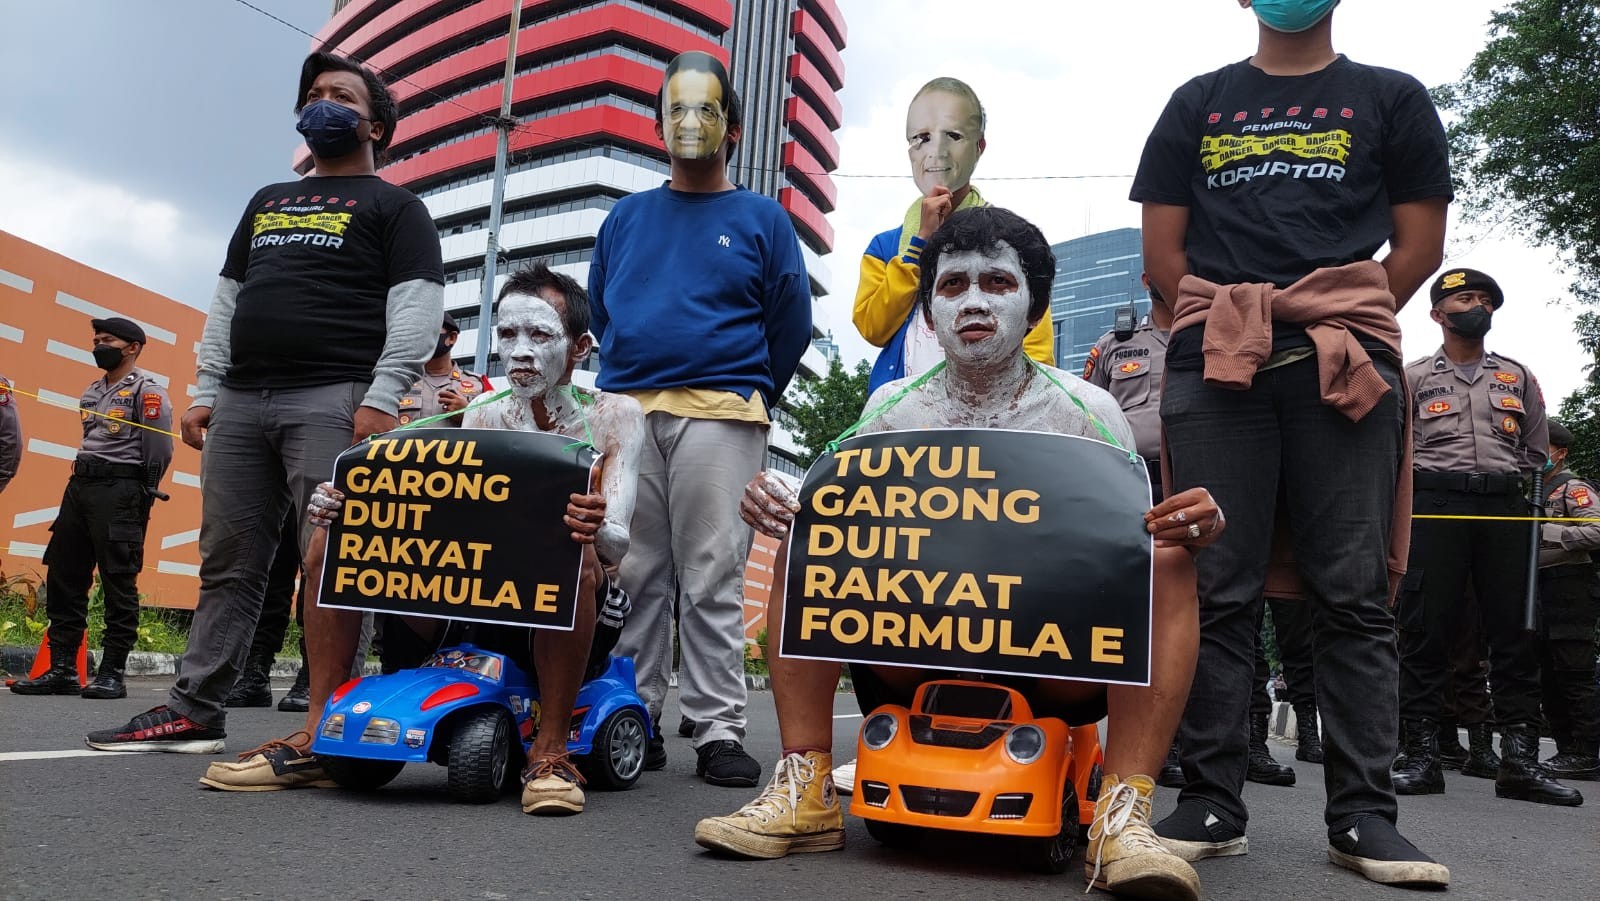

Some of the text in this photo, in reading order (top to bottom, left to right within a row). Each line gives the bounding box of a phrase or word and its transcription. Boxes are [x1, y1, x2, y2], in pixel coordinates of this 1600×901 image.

[1208, 106, 1354, 123] SATGAS
[1241, 120, 1312, 133] PEMBURU
[1219, 145, 1253, 162] DANGER
[1262, 136, 1296, 151] DANGER
[1305, 132, 1342, 146] DANGER
[1207, 161, 1346, 190] KORUPTOR
[280, 205, 325, 213] PEMBURU
[250, 233, 344, 251] KORUPTOR
[1489, 383, 1522, 398] POLRI
[366, 439, 484, 467] TUYUL
[834, 446, 996, 479] TUYUL
[346, 466, 511, 502] GARONG
[343, 499, 431, 531] DUIT
[811, 484, 1041, 523] GARONG
[339, 533, 492, 571] RAKYAT
[807, 524, 931, 561] DUIT
[334, 566, 560, 613] FORMULA E
[803, 565, 1022, 610] RAKYAT
[800, 606, 1125, 664] FORMULA E
